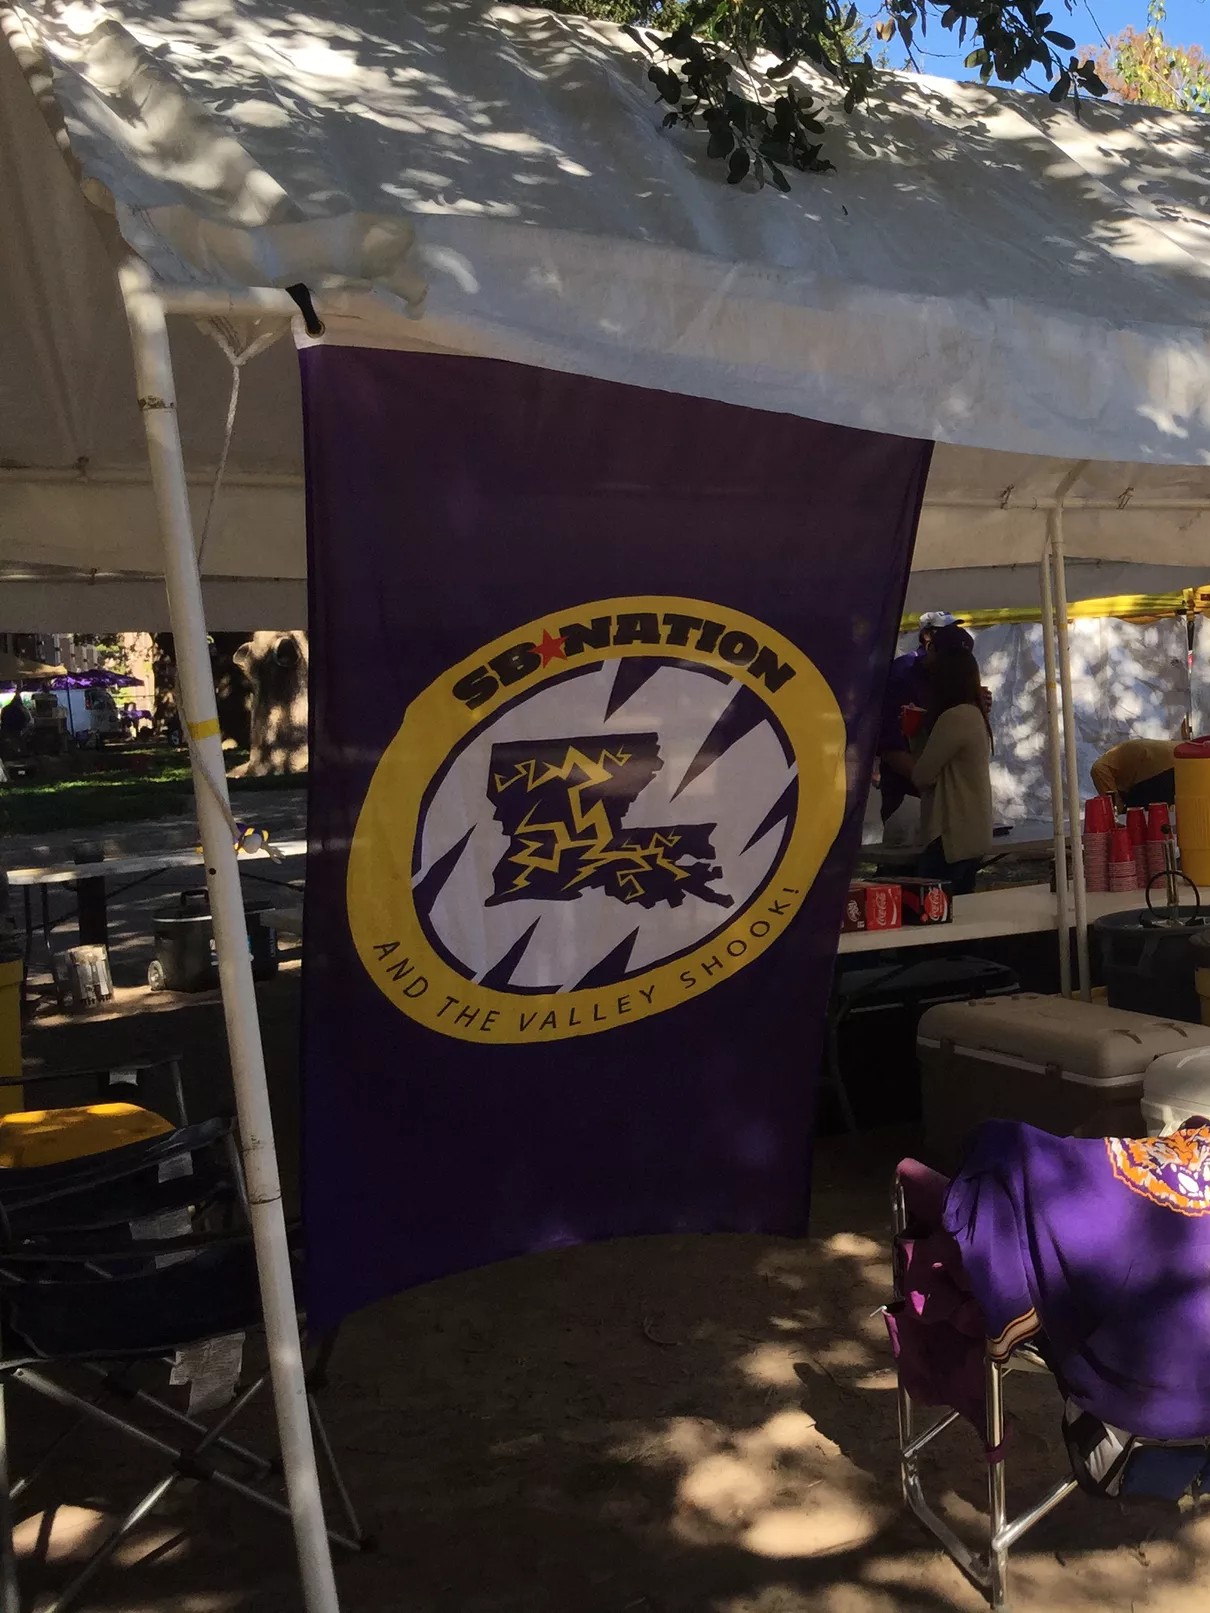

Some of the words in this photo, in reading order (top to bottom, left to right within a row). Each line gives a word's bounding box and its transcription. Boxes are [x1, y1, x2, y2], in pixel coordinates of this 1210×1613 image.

[559, 612, 797, 694] NATION
[373, 941, 429, 998] AND
[437, 996, 500, 1031] THE
[519, 985, 655, 1031] VALLEY
[679, 887, 800, 989] SHOOK!
